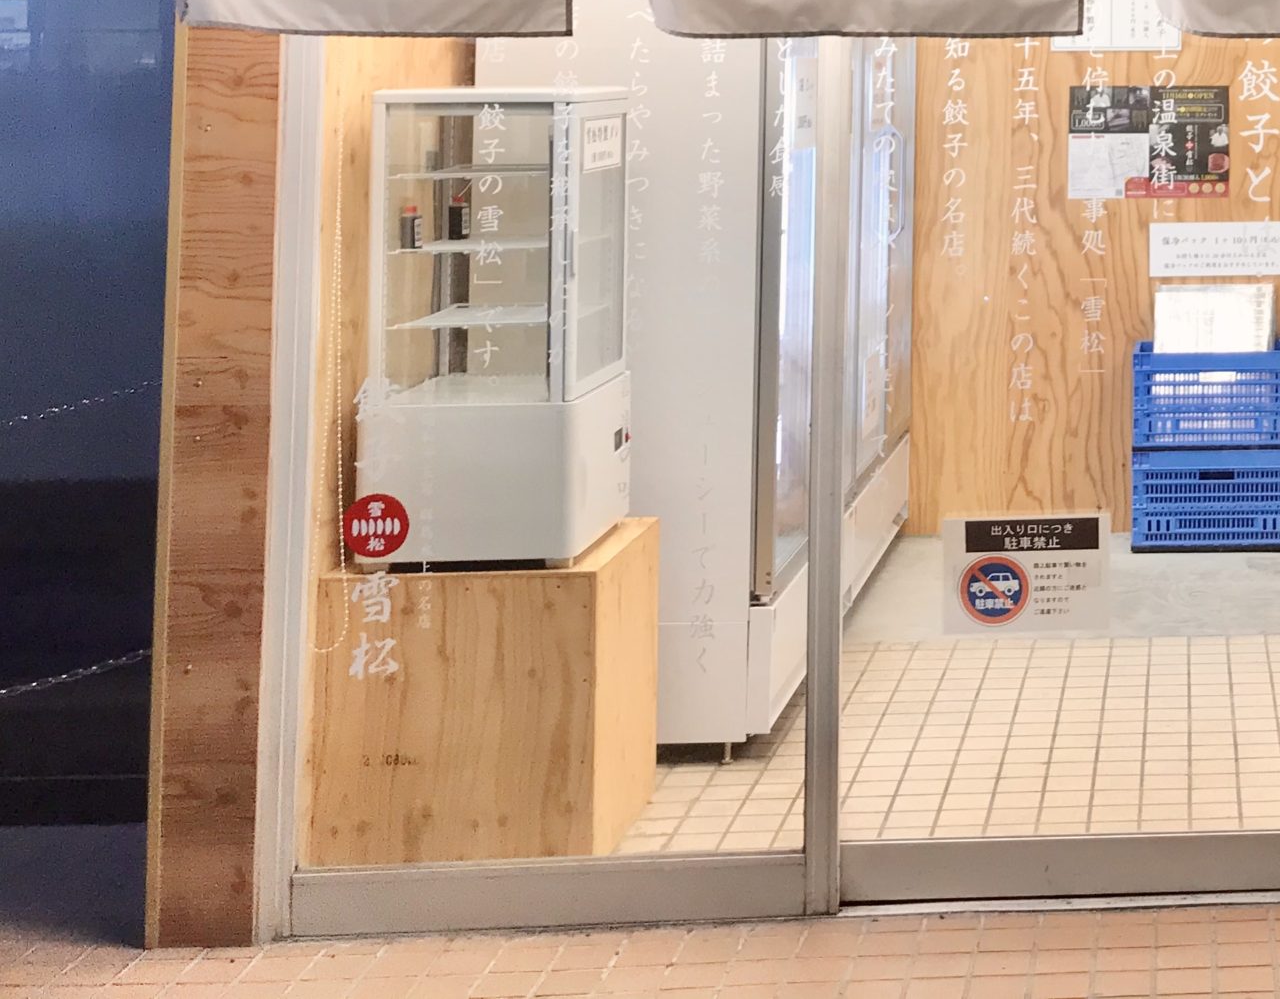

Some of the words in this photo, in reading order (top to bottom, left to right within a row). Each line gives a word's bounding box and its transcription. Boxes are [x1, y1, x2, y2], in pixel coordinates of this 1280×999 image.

[990, 523, 1075, 536] 出入り口につき
[1003, 536, 1062, 550] 駐車禁止
